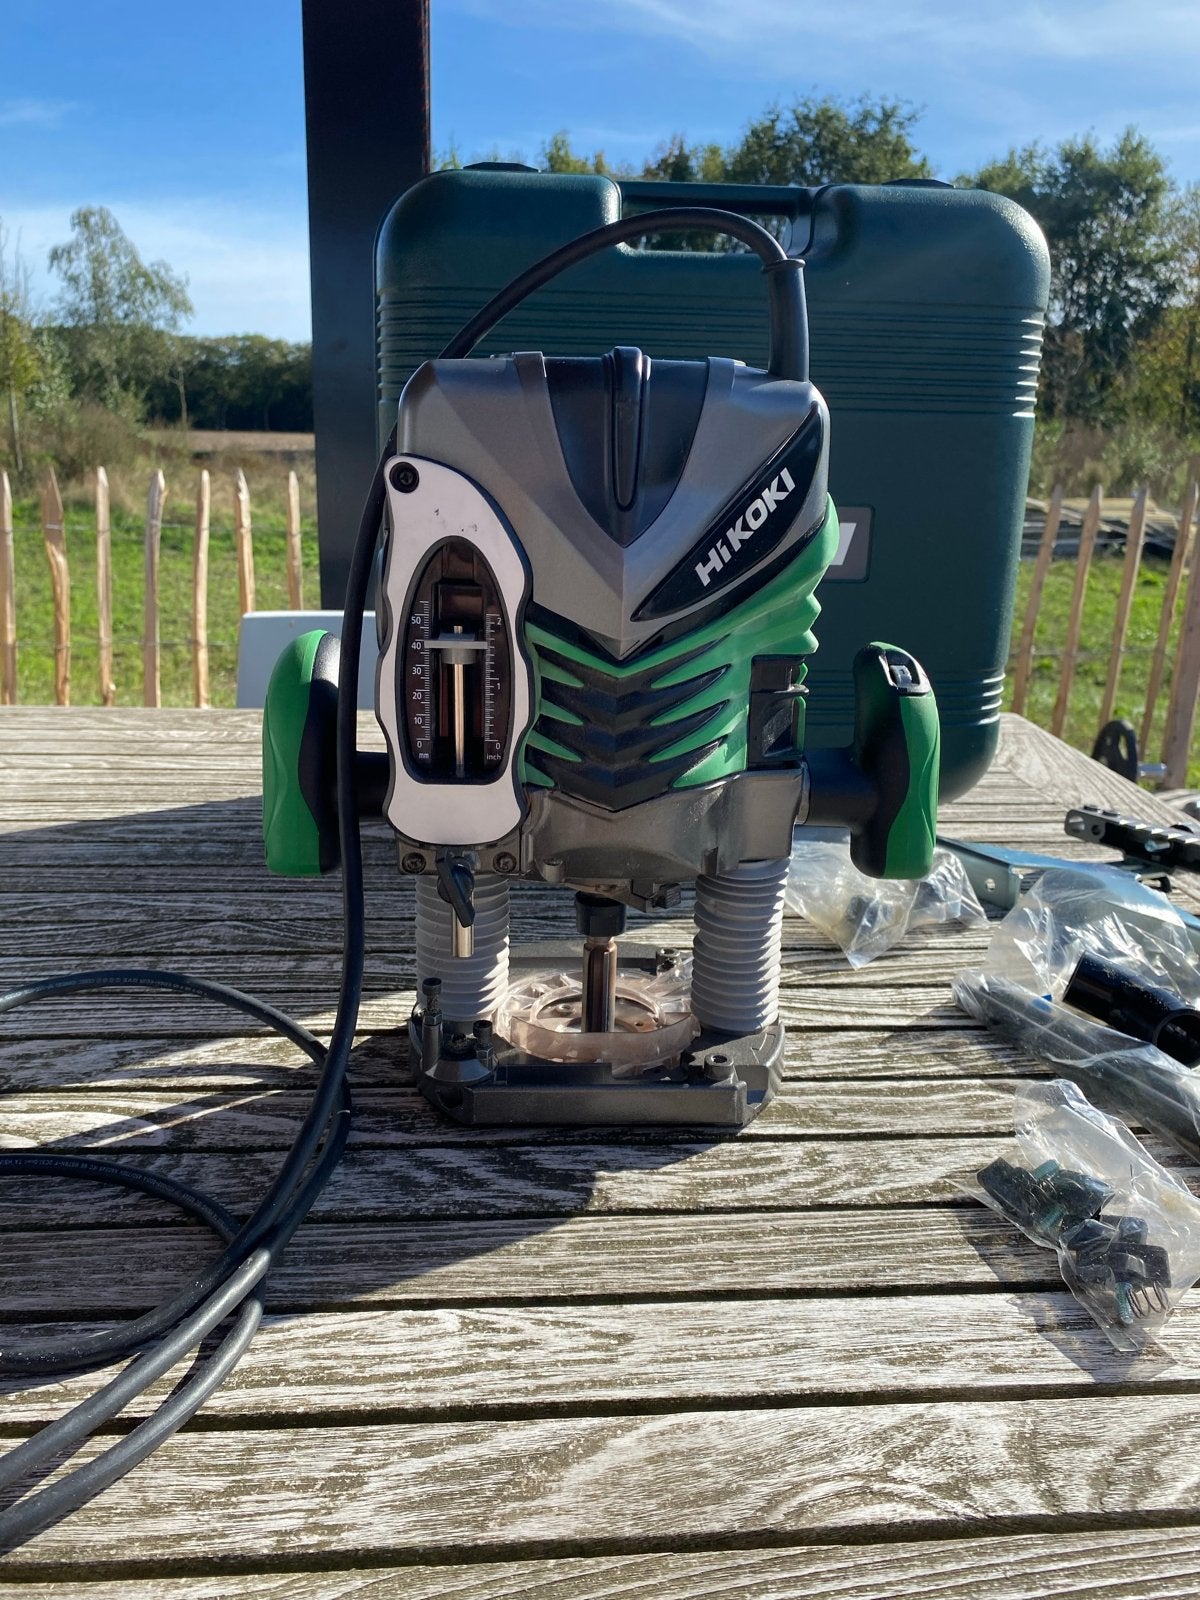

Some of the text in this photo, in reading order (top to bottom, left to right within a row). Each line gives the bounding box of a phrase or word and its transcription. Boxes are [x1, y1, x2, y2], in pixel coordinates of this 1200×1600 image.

[695, 467, 796, 587] HiKOKI
[411, 616, 421, 625] 50
[497, 617, 502, 626] 2
[411, 641, 421, 650] 40
[412, 667, 422, 675] 30
[496, 682, 501, 690] 1
[412, 692, 422, 700] 20
[414, 717, 422, 725] 10
[495, 742, 500, 750] 0
[486, 752, 501, 760] inch
